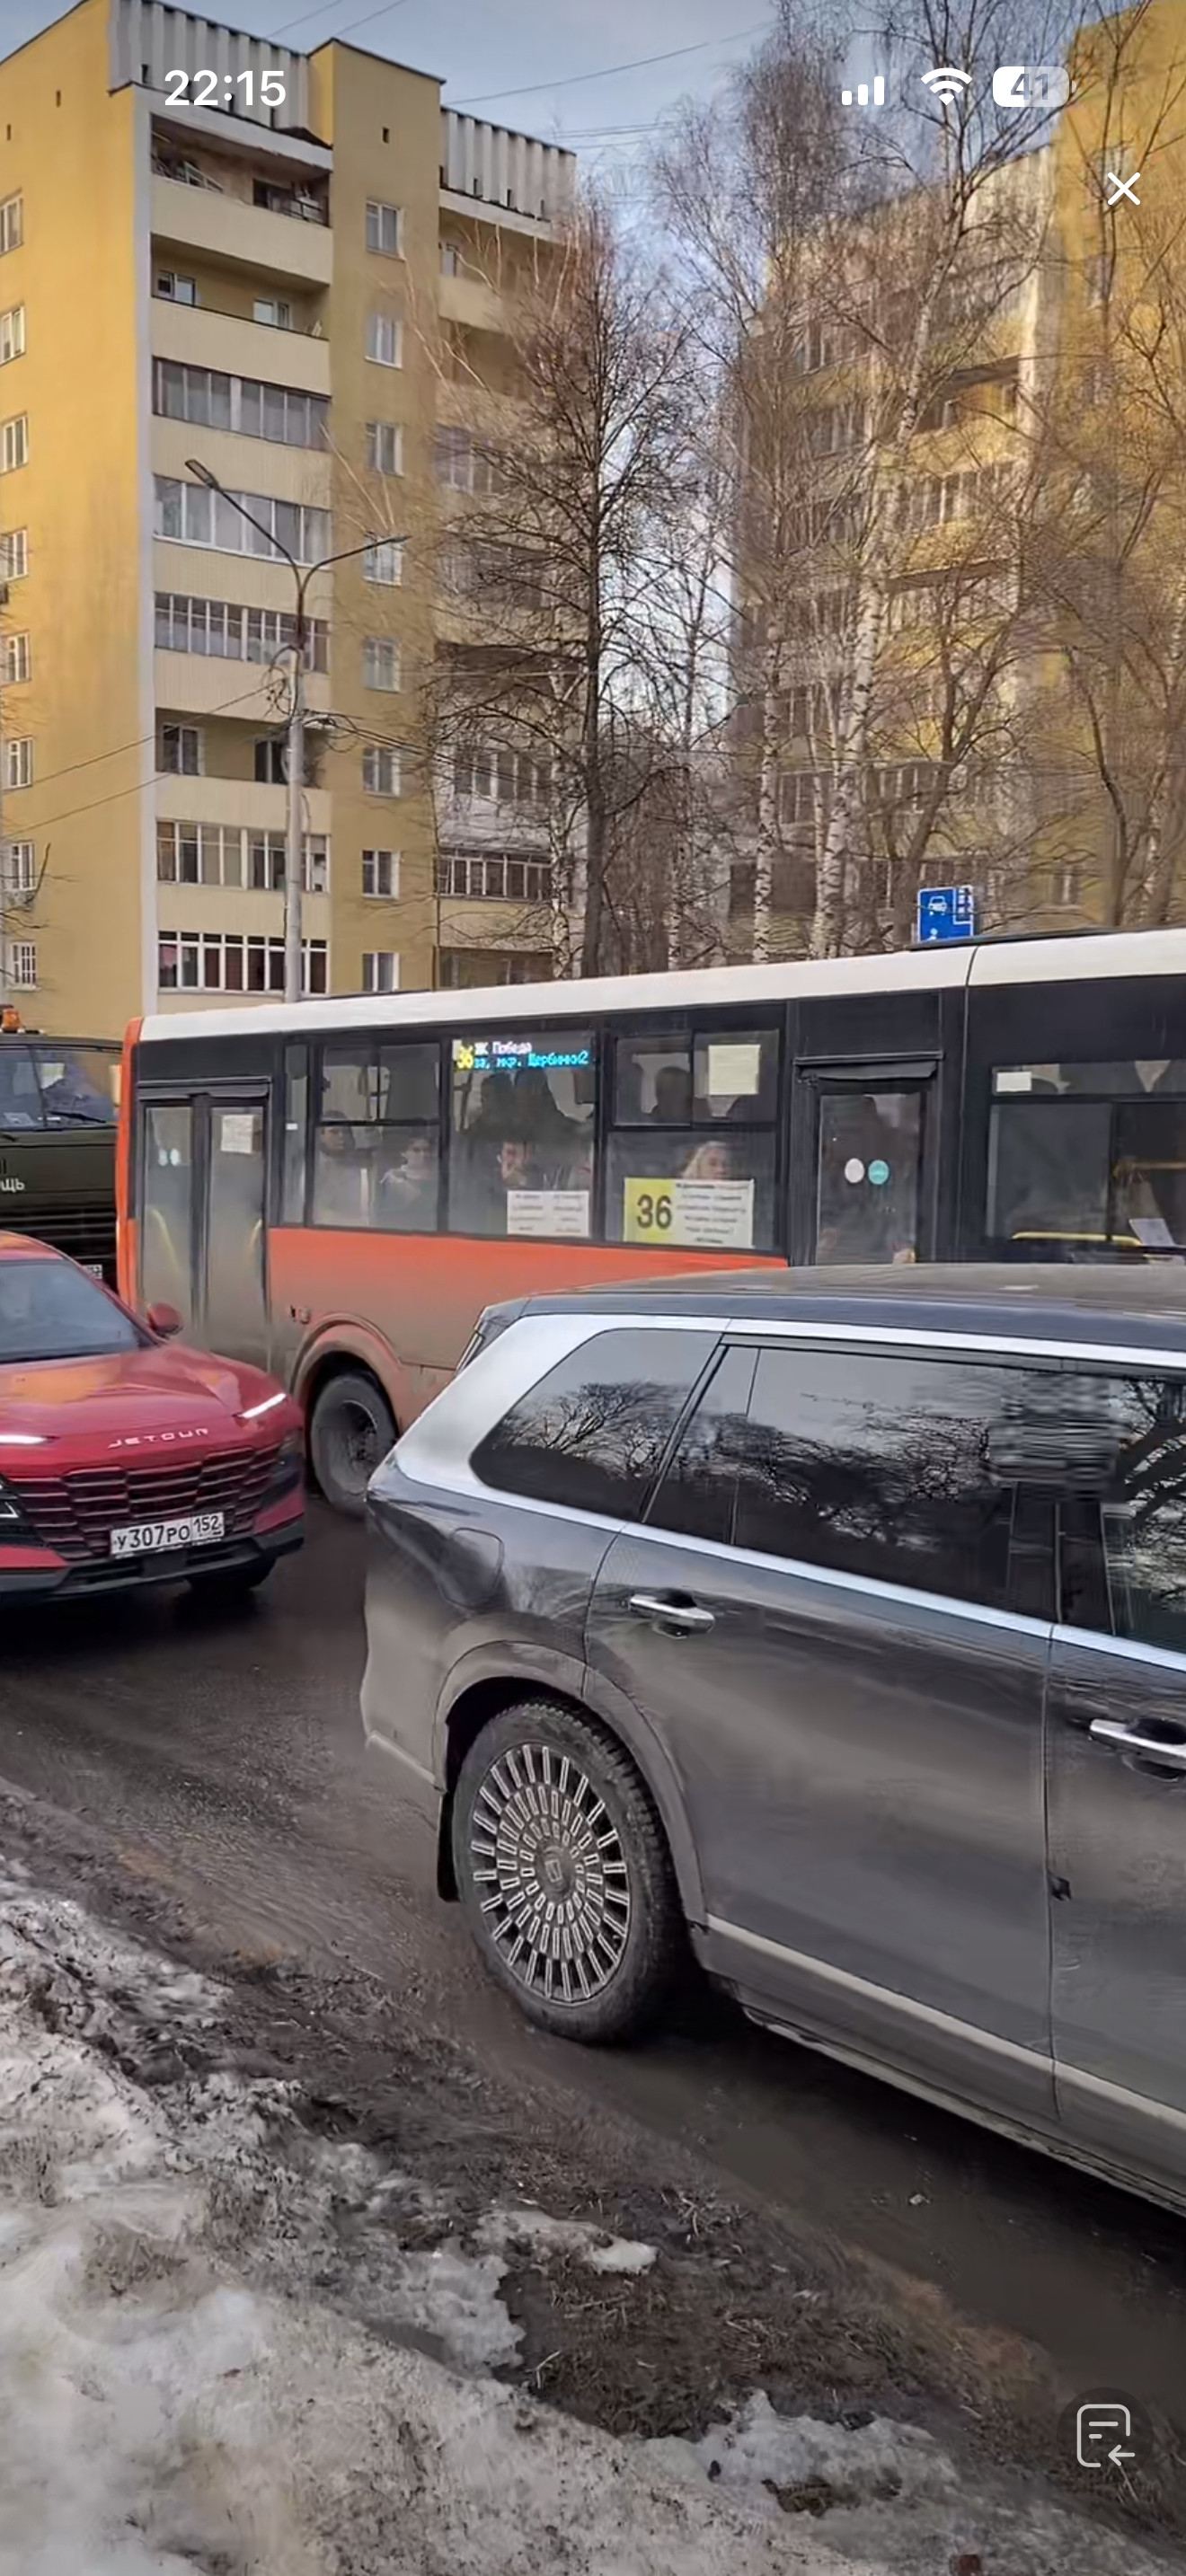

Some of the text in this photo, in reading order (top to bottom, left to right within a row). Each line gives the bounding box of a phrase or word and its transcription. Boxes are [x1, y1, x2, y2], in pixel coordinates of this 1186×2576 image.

[637, 1195, 672, 1229] 36
[107, 1428, 208, 1449] JETOUR
[194, 1515, 219, 1533] 152
